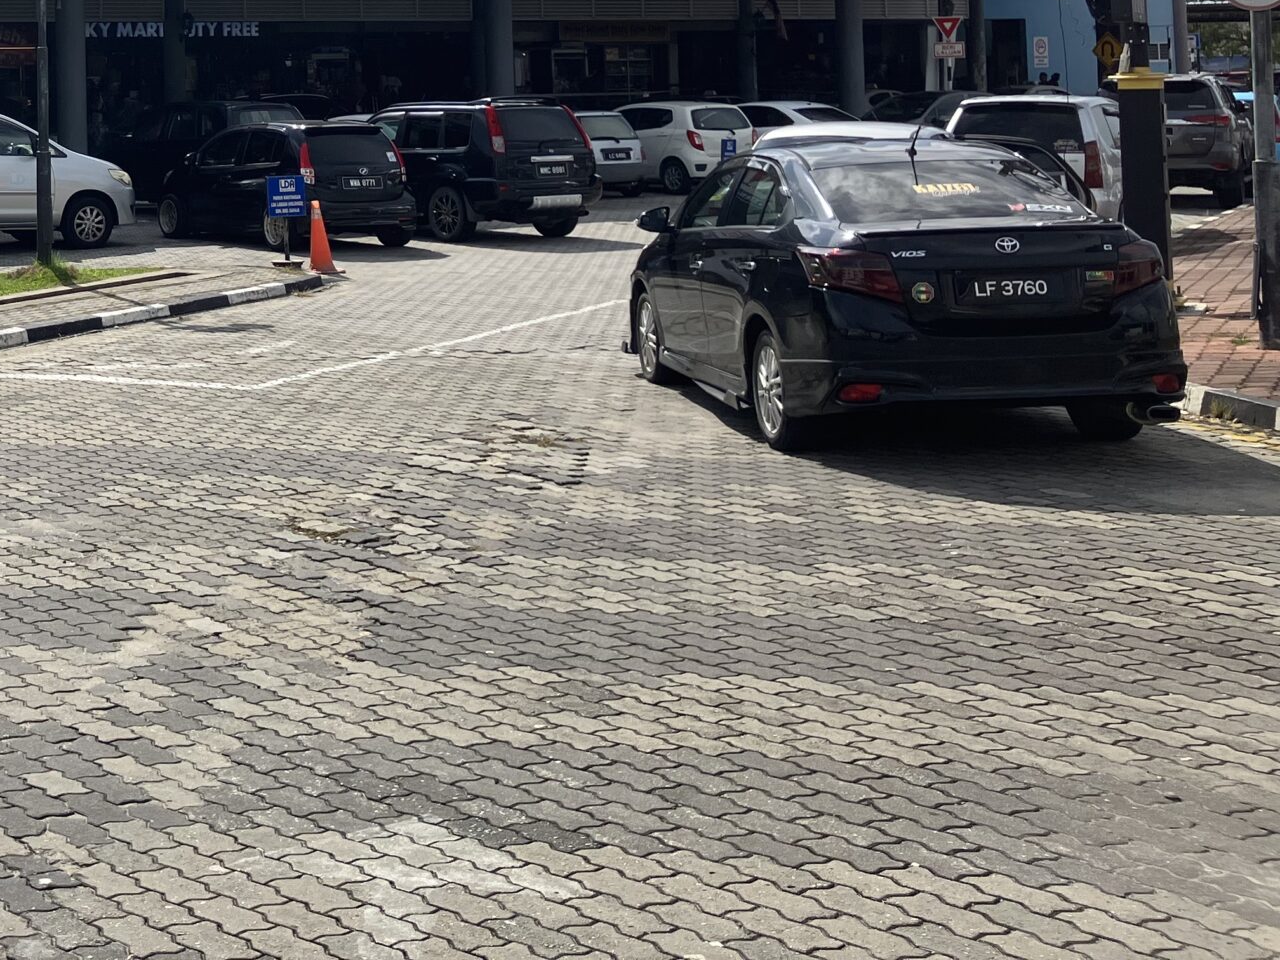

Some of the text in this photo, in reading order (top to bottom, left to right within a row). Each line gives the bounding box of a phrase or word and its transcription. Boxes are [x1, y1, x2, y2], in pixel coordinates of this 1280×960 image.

[222, 22, 259, 37] FREE
[280, 179, 295, 189] LDA
[890, 249, 927, 258] VIOS
[974, 279, 1048, 297] LF 3760
